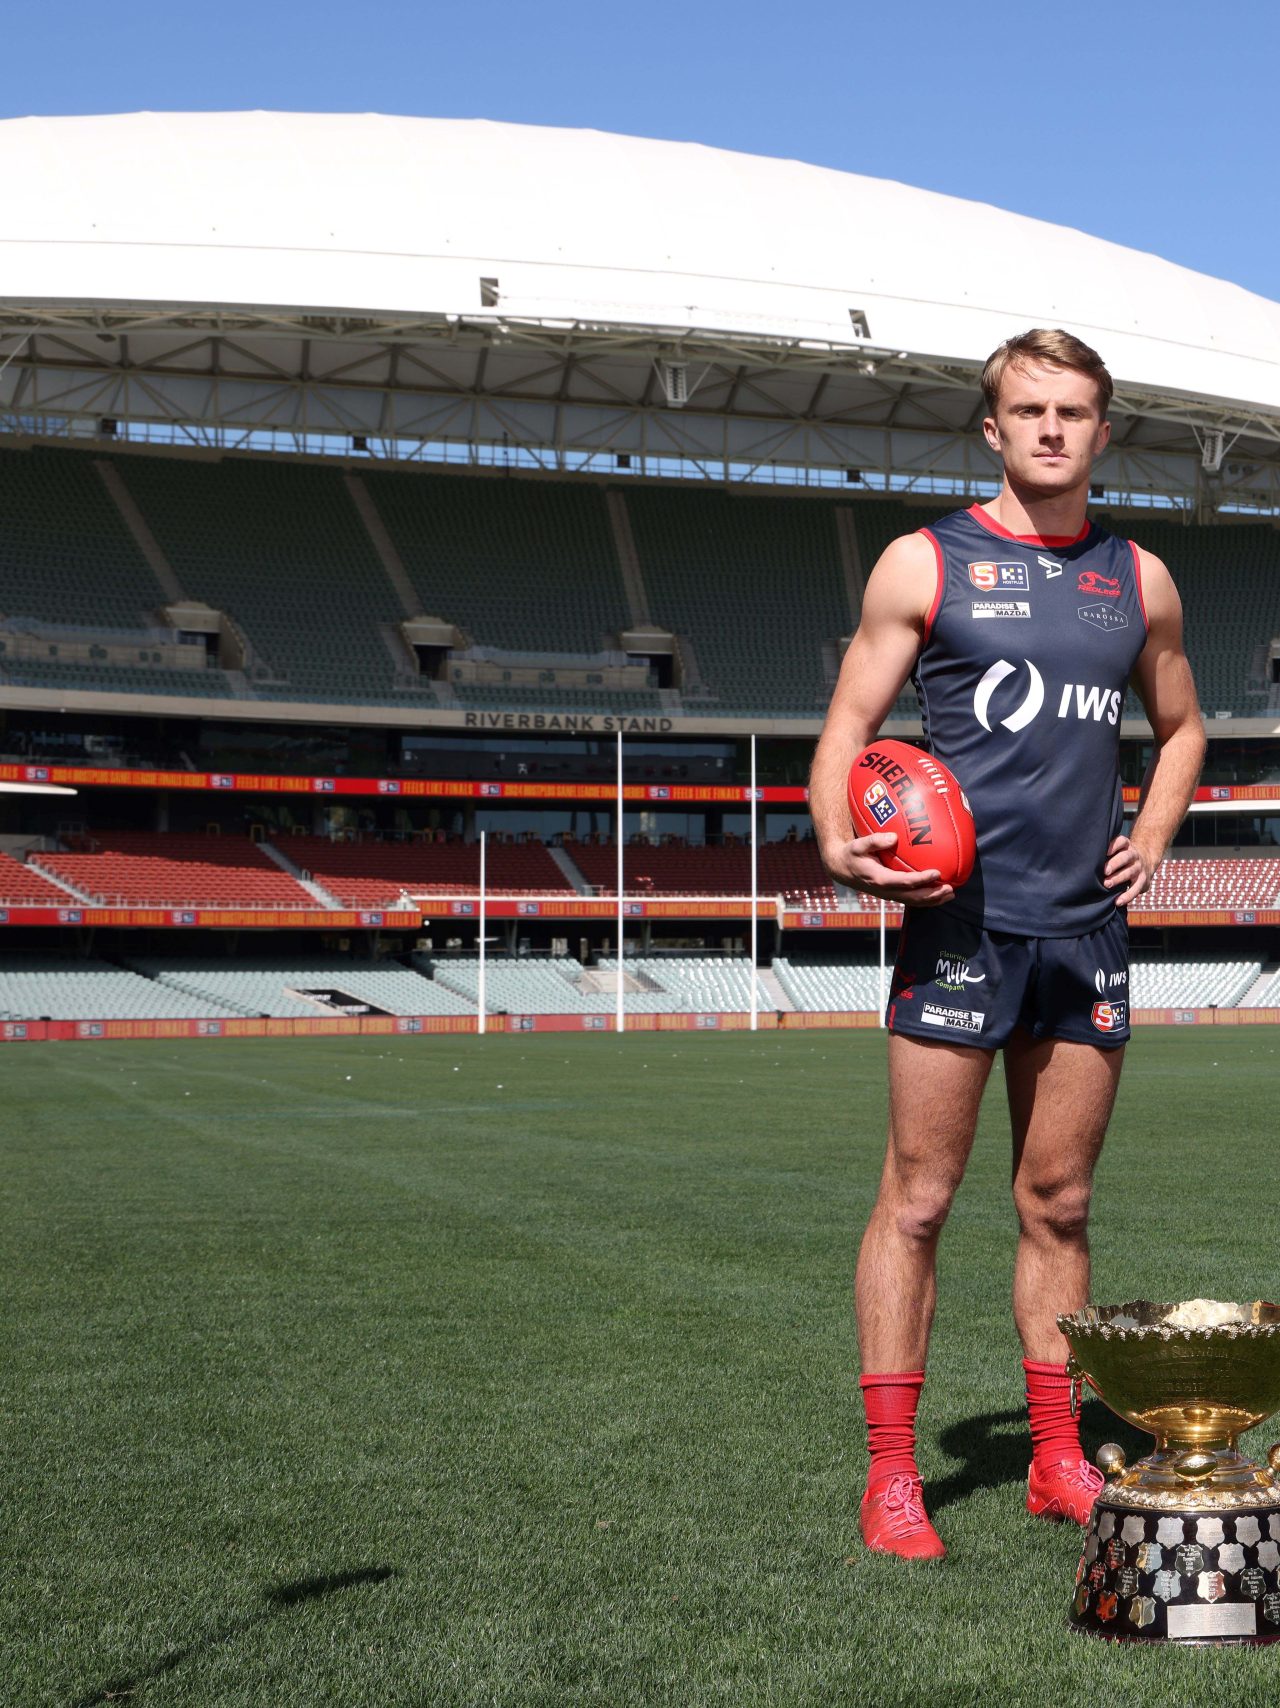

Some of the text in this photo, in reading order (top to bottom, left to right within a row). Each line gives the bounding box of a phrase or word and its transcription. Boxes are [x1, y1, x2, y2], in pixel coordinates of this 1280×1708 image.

[1058, 684, 1121, 725] IWS
[465, 712, 672, 732] RIVERBANK STAND
[858, 752, 933, 848] SHERRIN
[936, 958, 986, 985] Milk
[1109, 971, 1127, 987] IWS
[935, 979, 965, 992] Company
[924, 1004, 970, 1020] PARADISE
[946, 1018, 979, 1031] MAZDA
